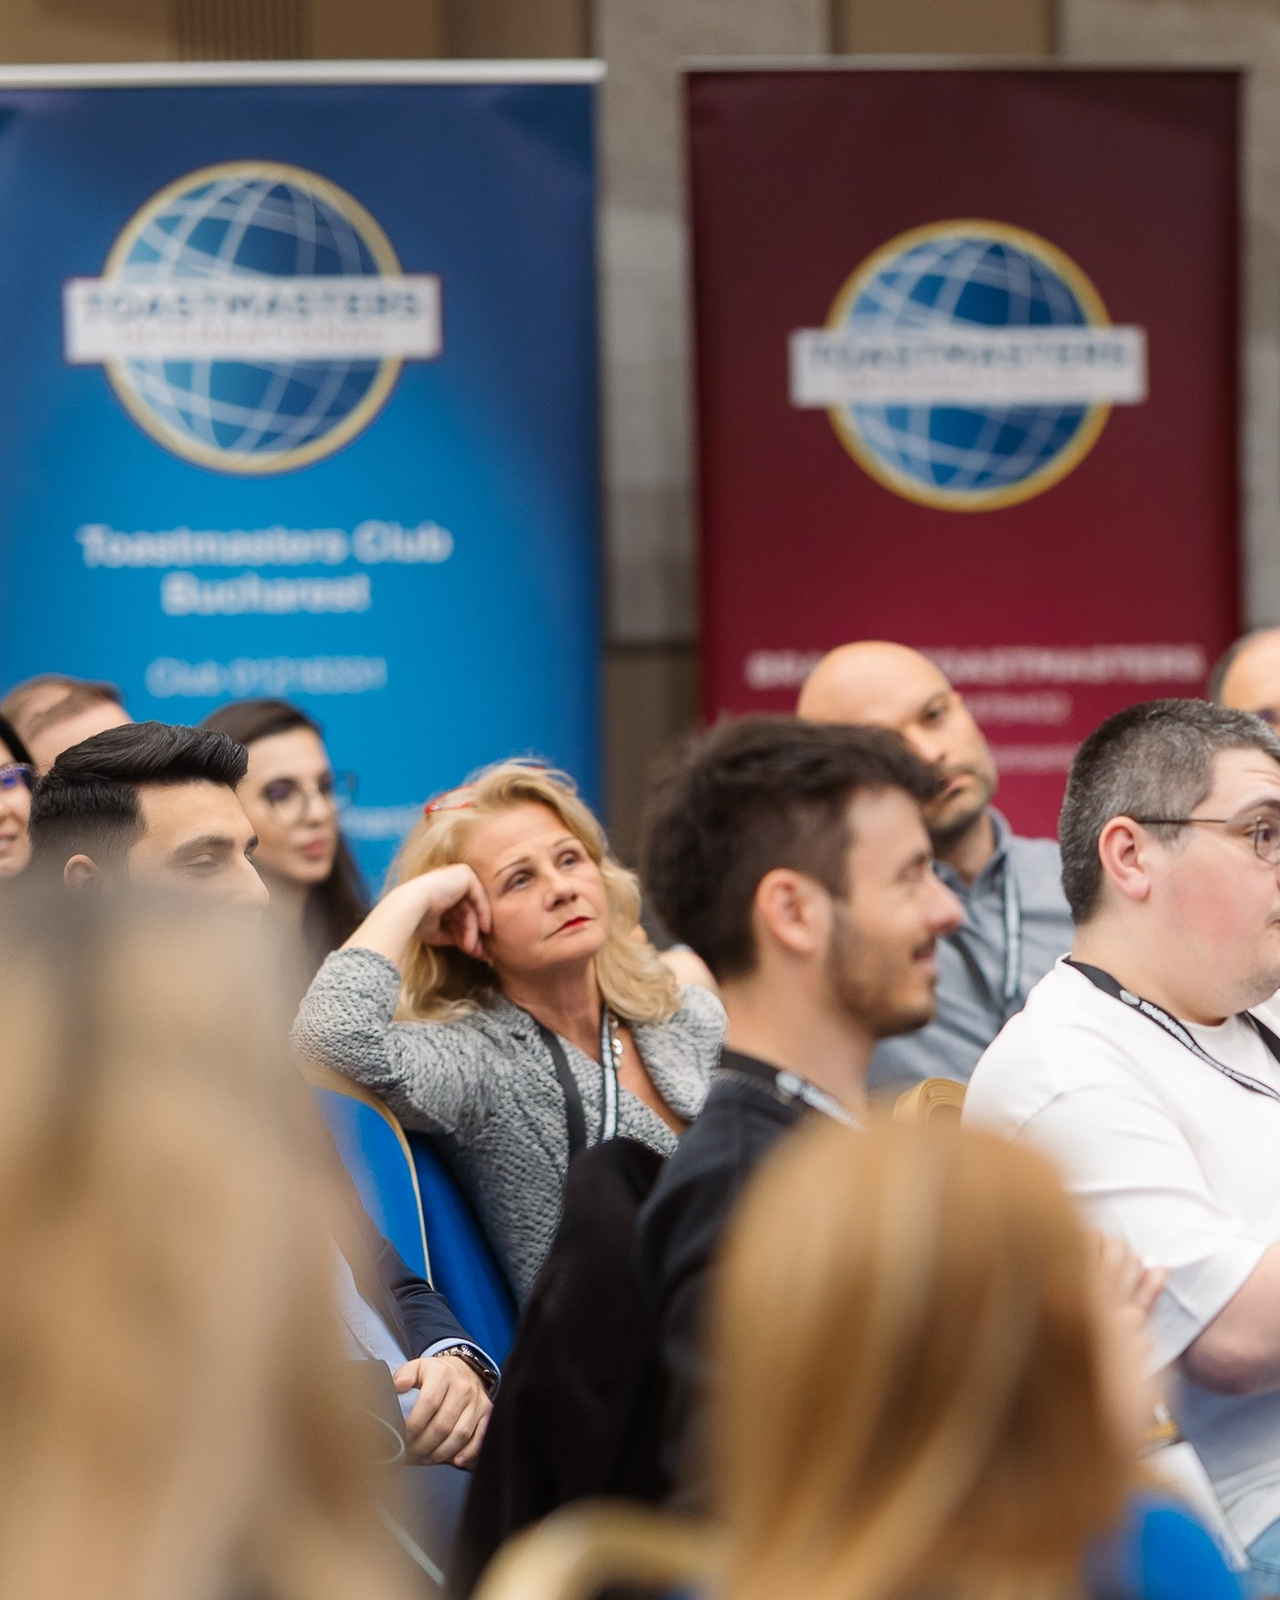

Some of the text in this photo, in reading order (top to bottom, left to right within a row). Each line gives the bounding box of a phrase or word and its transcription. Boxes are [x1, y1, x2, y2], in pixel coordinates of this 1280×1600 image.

[82, 291, 423, 324] TOASTMASTERS
[78, 521, 452, 566] Toastmasters Club
